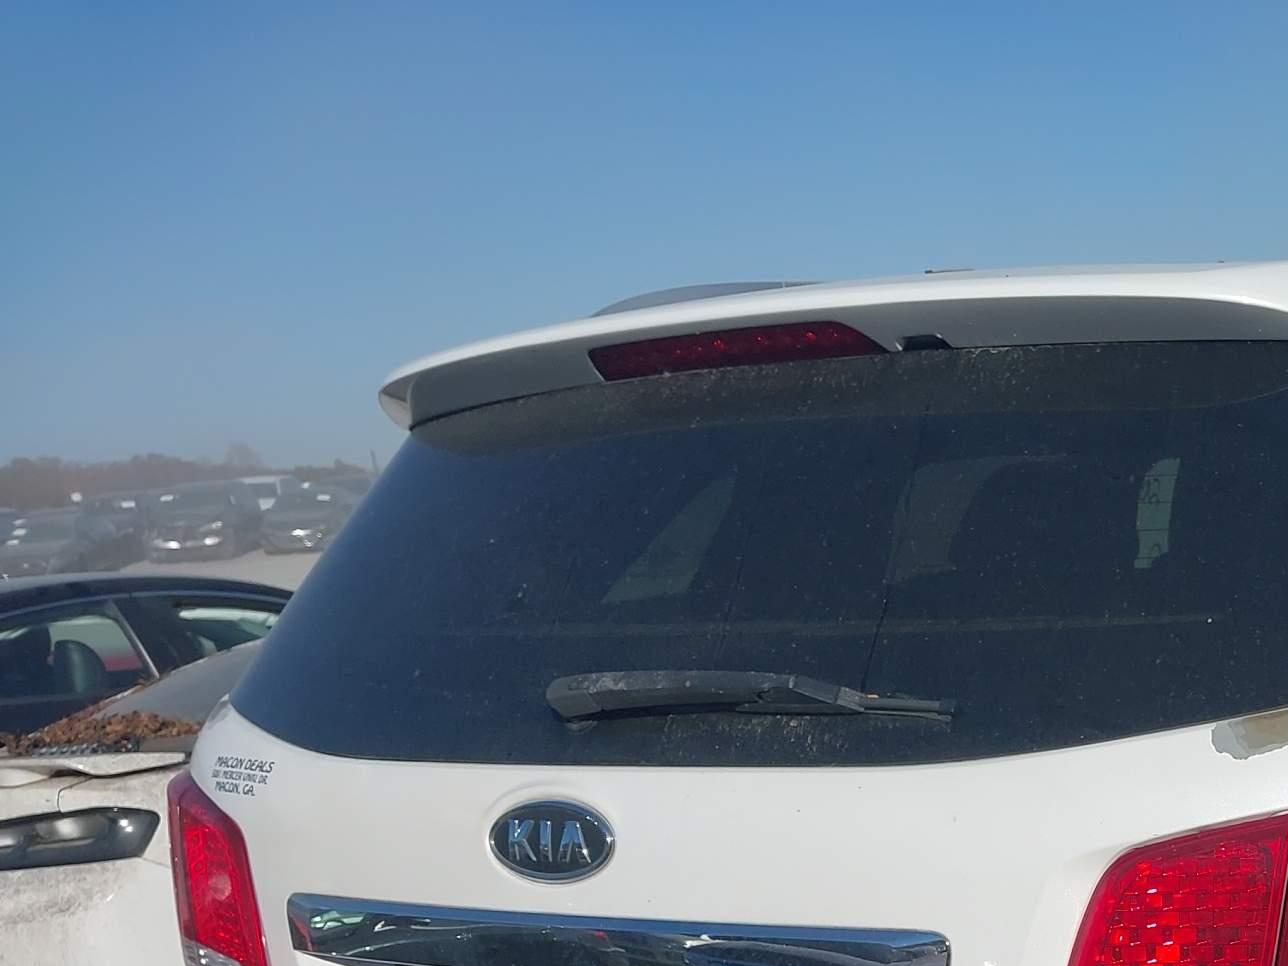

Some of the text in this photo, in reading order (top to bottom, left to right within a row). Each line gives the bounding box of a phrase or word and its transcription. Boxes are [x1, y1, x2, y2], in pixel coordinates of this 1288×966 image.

[215, 756, 275, 774] MACON DEALS
[507, 818, 592, 864] KIA
